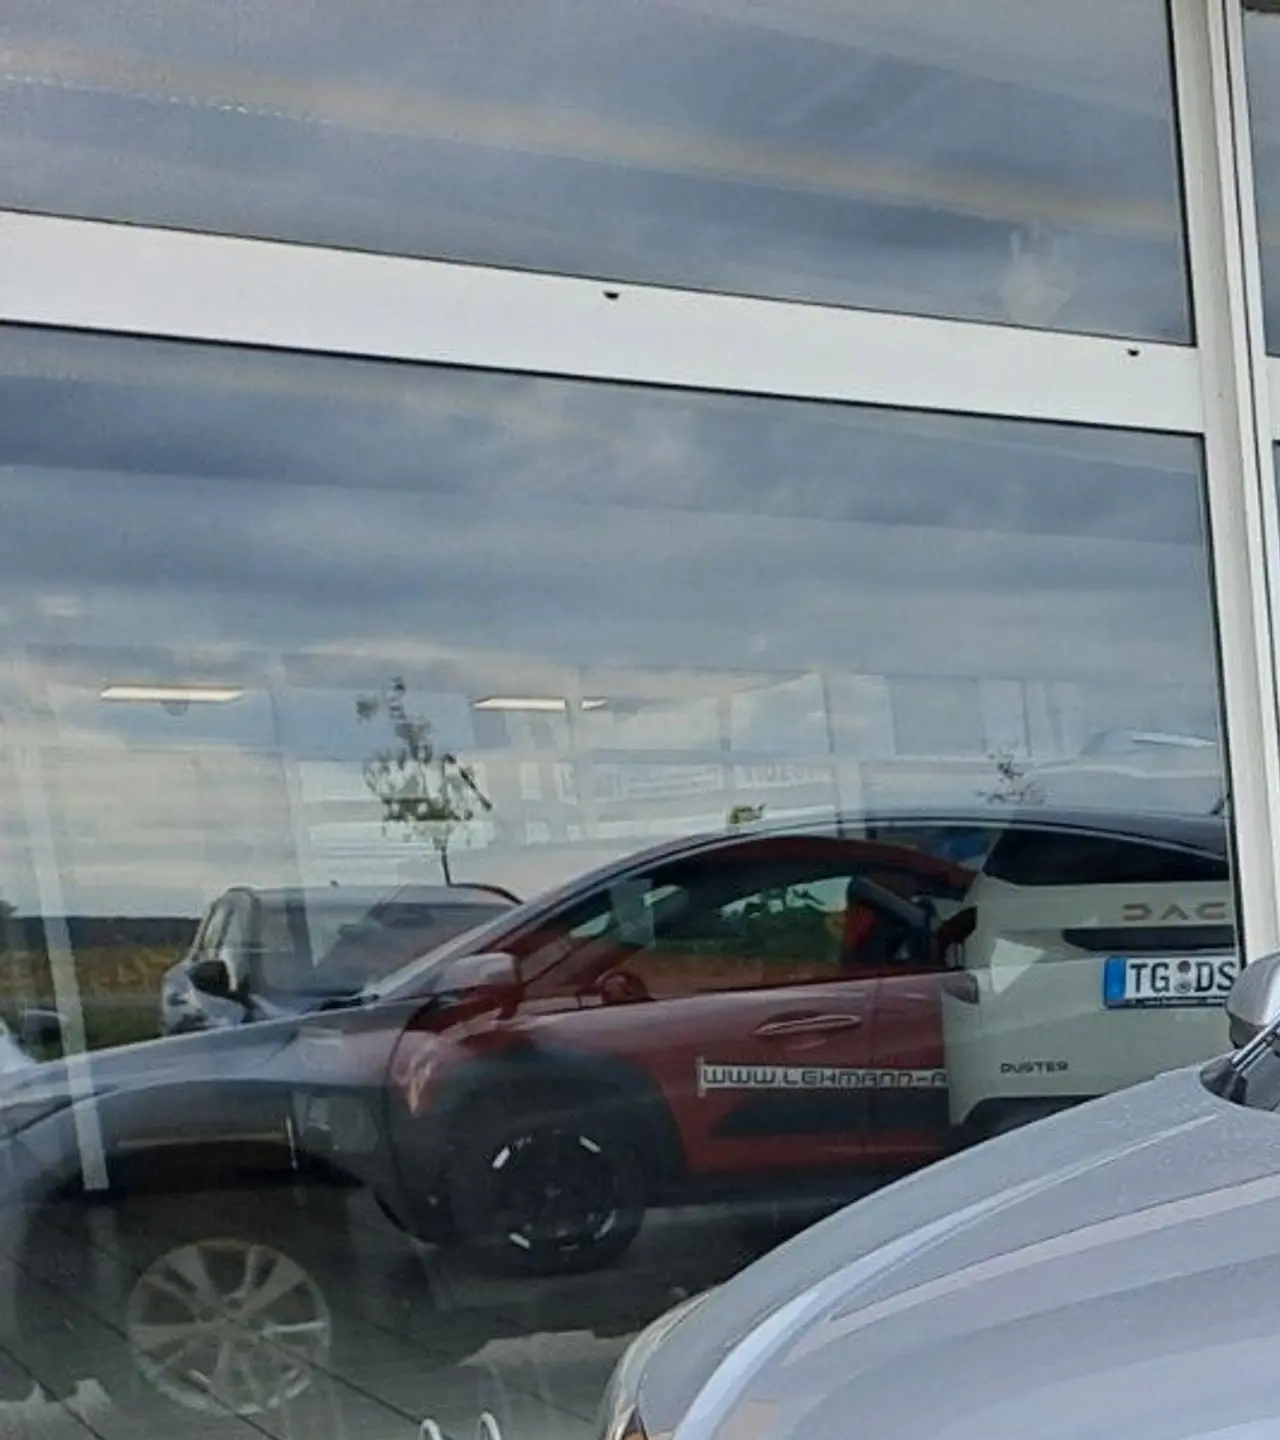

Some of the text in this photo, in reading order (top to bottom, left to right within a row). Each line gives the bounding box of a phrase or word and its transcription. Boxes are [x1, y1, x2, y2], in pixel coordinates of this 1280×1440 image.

[1128, 960, 1237, 994] TG DS
[1000, 1060, 1070, 1075] DUSTER
